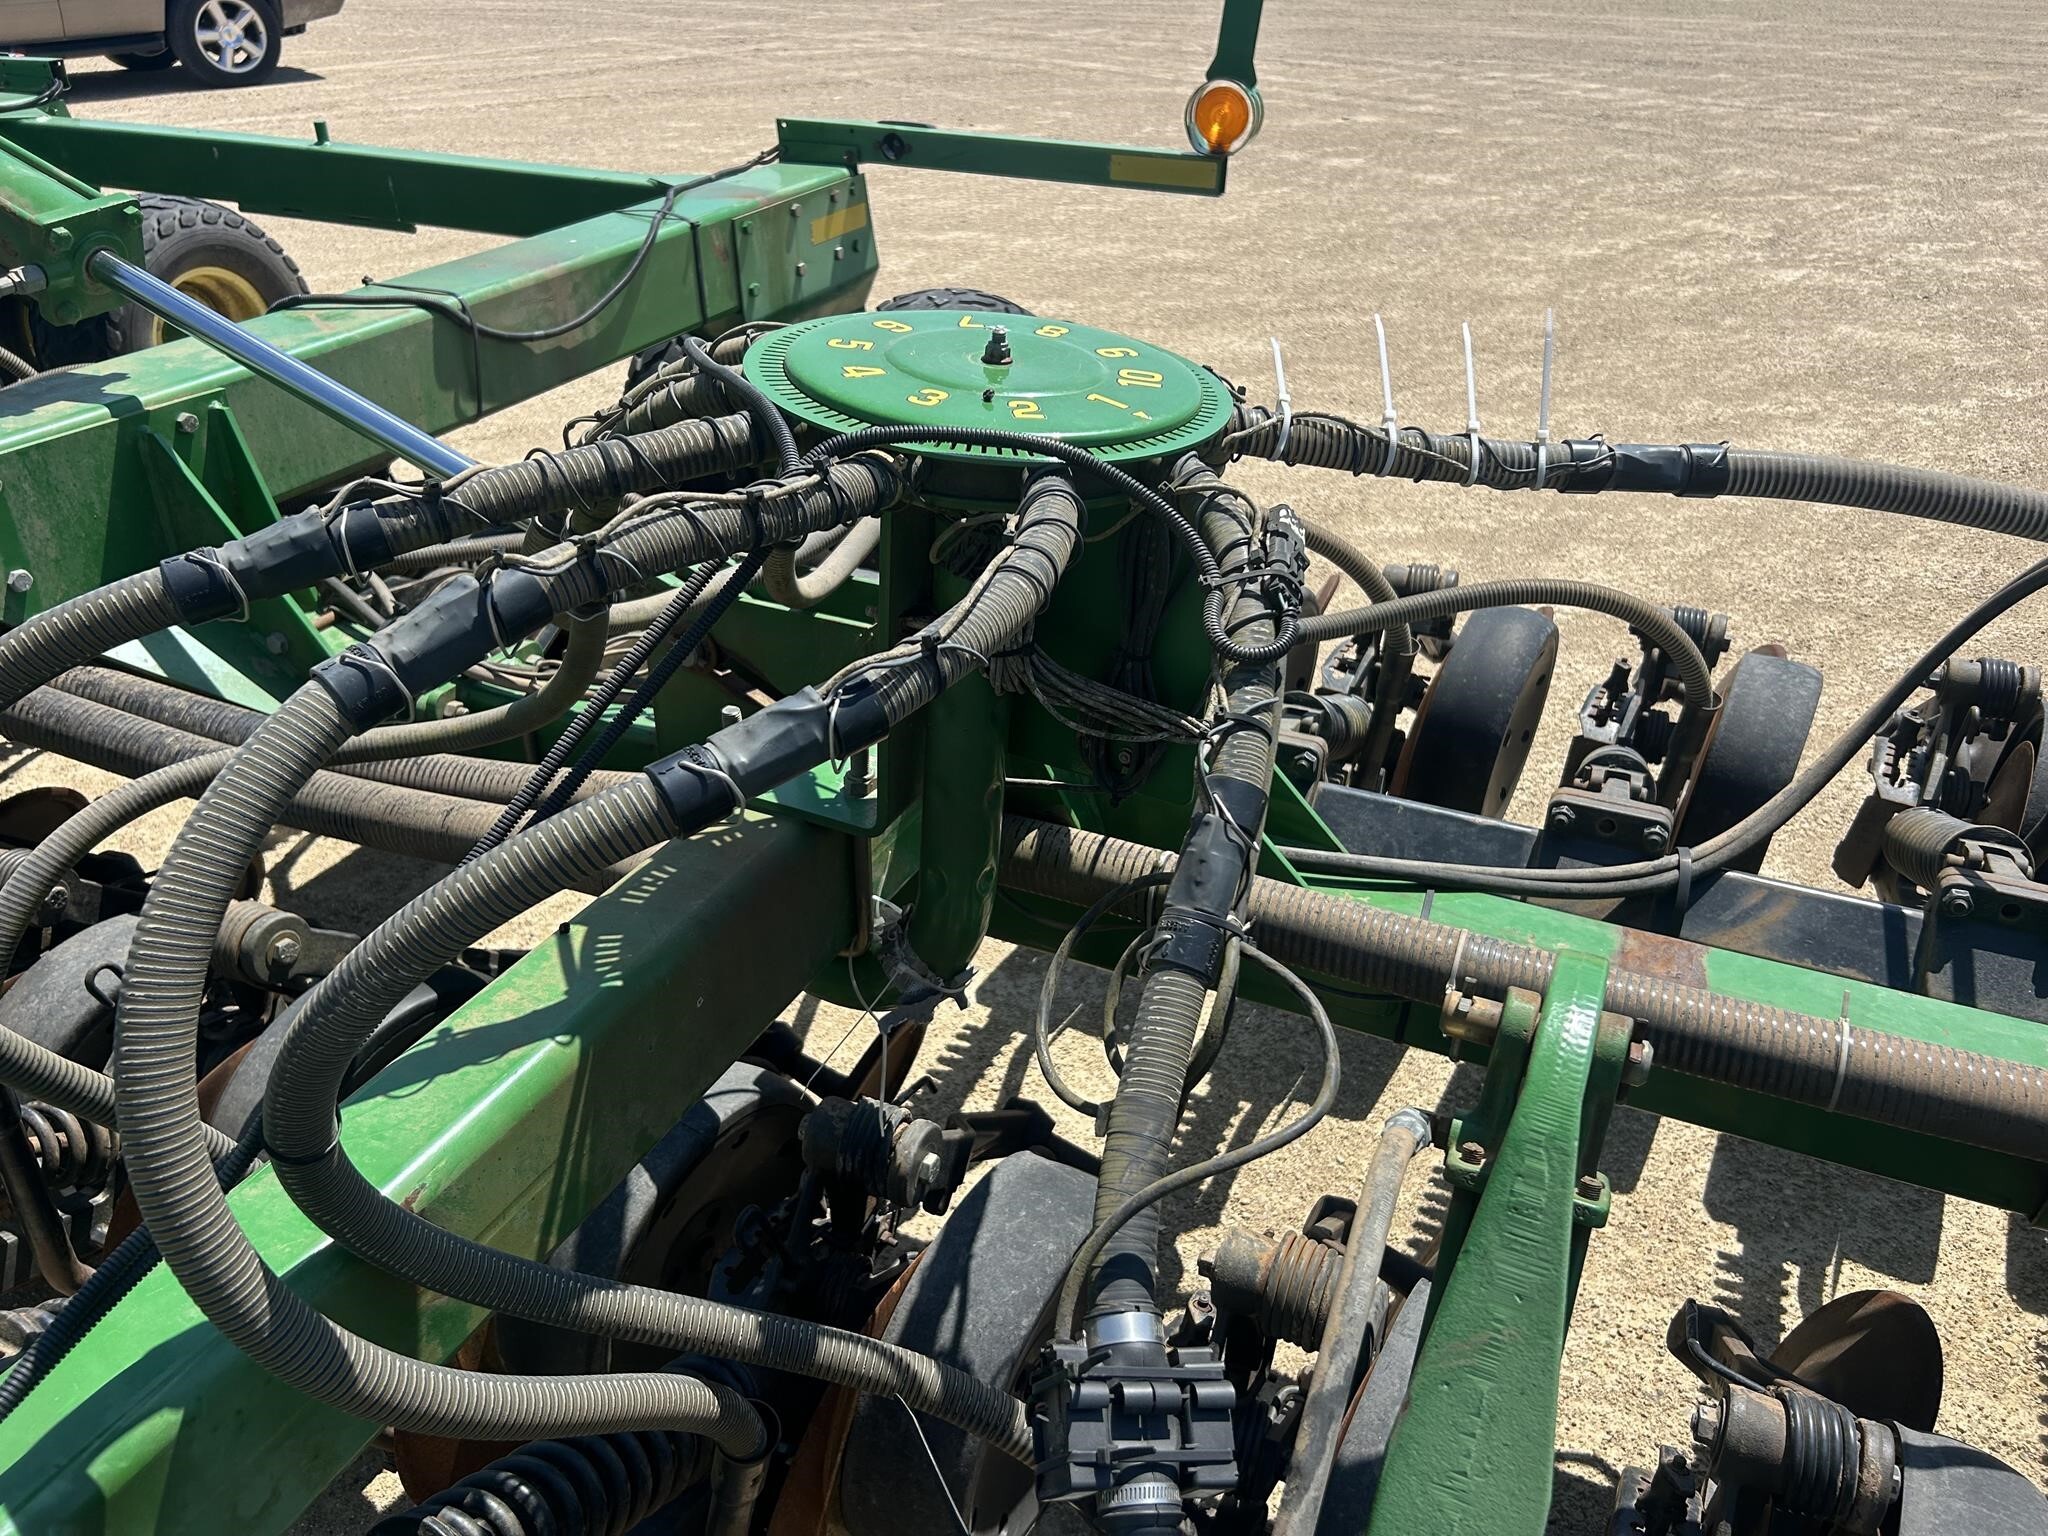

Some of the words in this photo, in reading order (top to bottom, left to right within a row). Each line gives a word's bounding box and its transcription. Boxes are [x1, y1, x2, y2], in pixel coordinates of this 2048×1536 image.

[872, 319, 914, 333] 6
[958, 315, 986, 329] 7
[1034, 324, 1071, 338] 8
[826, 338, 876, 351] 5
[1095, 347, 1139, 358] 9
[841, 364, 888, 379] 4
[1116, 368, 1164, 389] 10
[906, 388, 950, 407] 3
[1086, 393, 1130, 410] 1
[1007, 400, 1047, 421] 2
